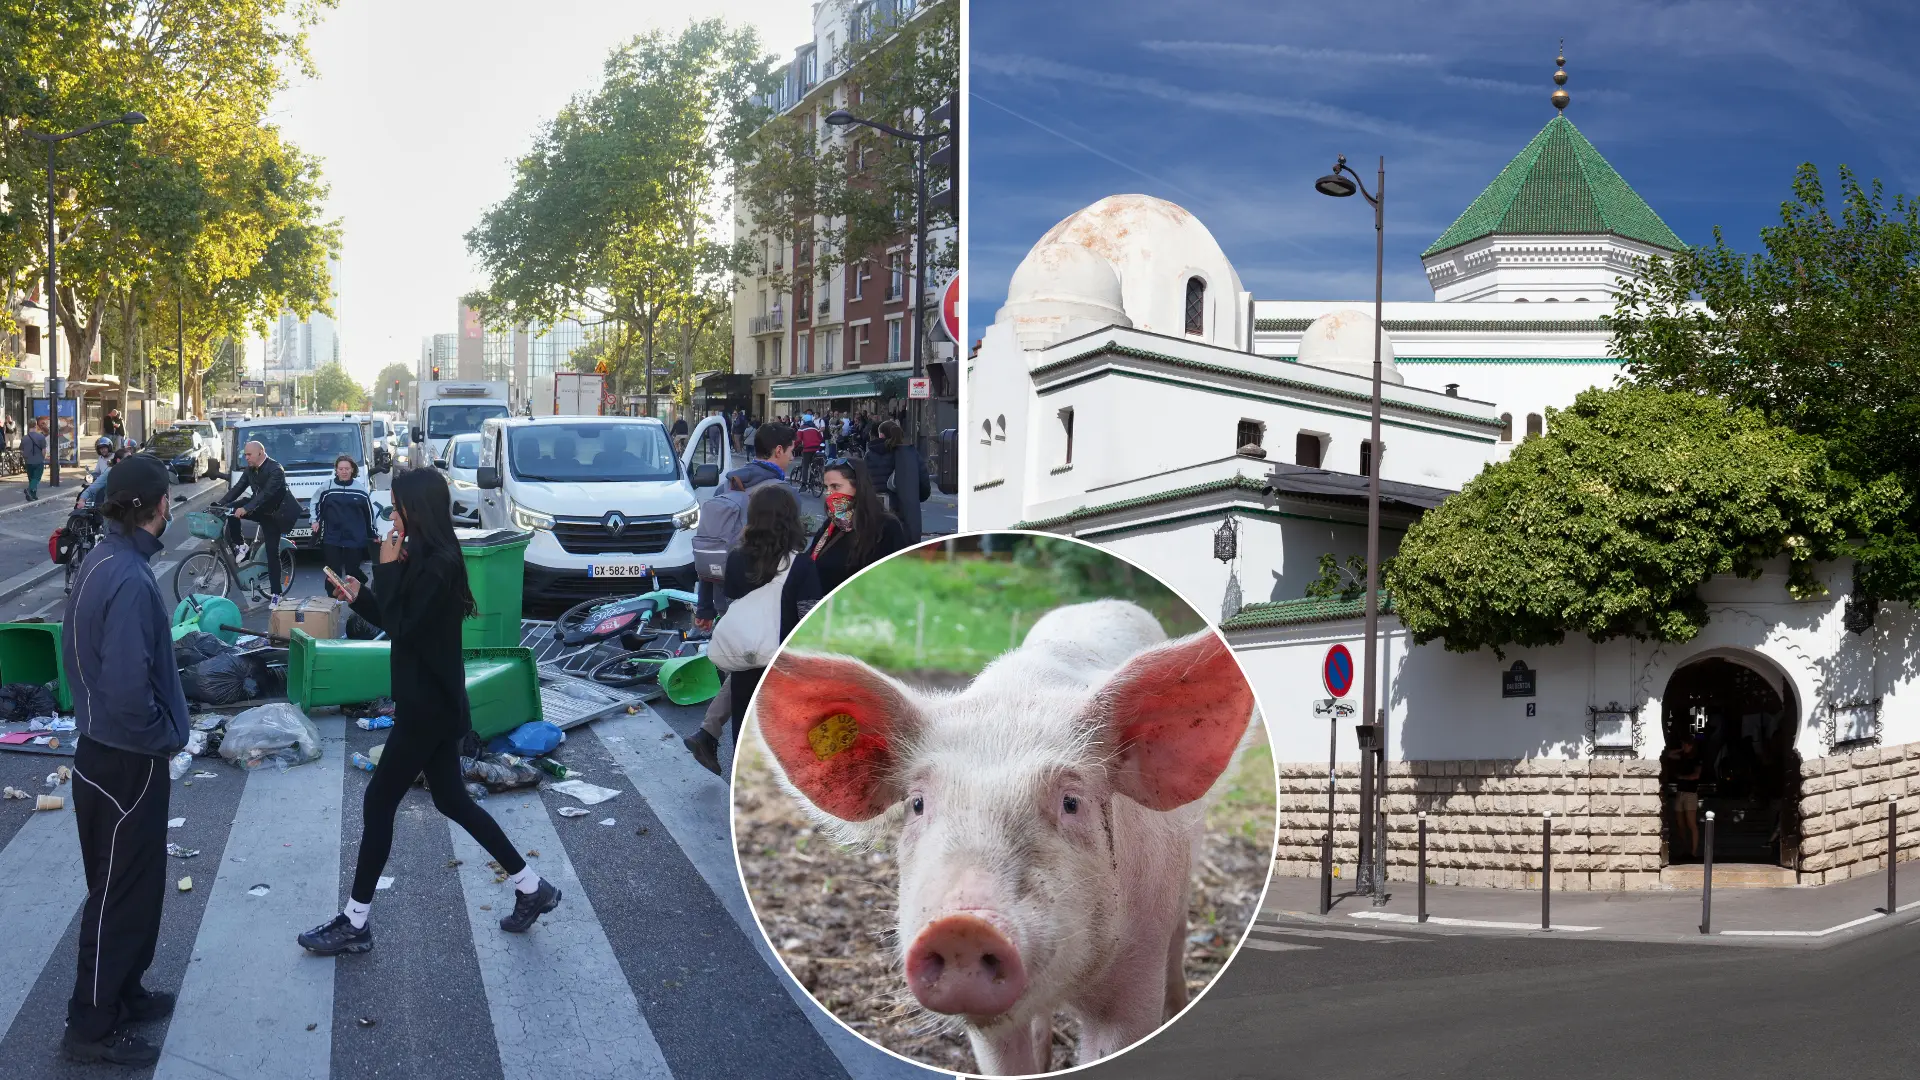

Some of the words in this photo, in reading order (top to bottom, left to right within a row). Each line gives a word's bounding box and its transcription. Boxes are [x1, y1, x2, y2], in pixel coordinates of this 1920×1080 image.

[594, 566, 640, 576] GX-582-KB
[1514, 674, 1523, 682] RUE
[1506, 682, 1531, 690] DAUBENTON
[1528, 703, 1534, 716] 2
